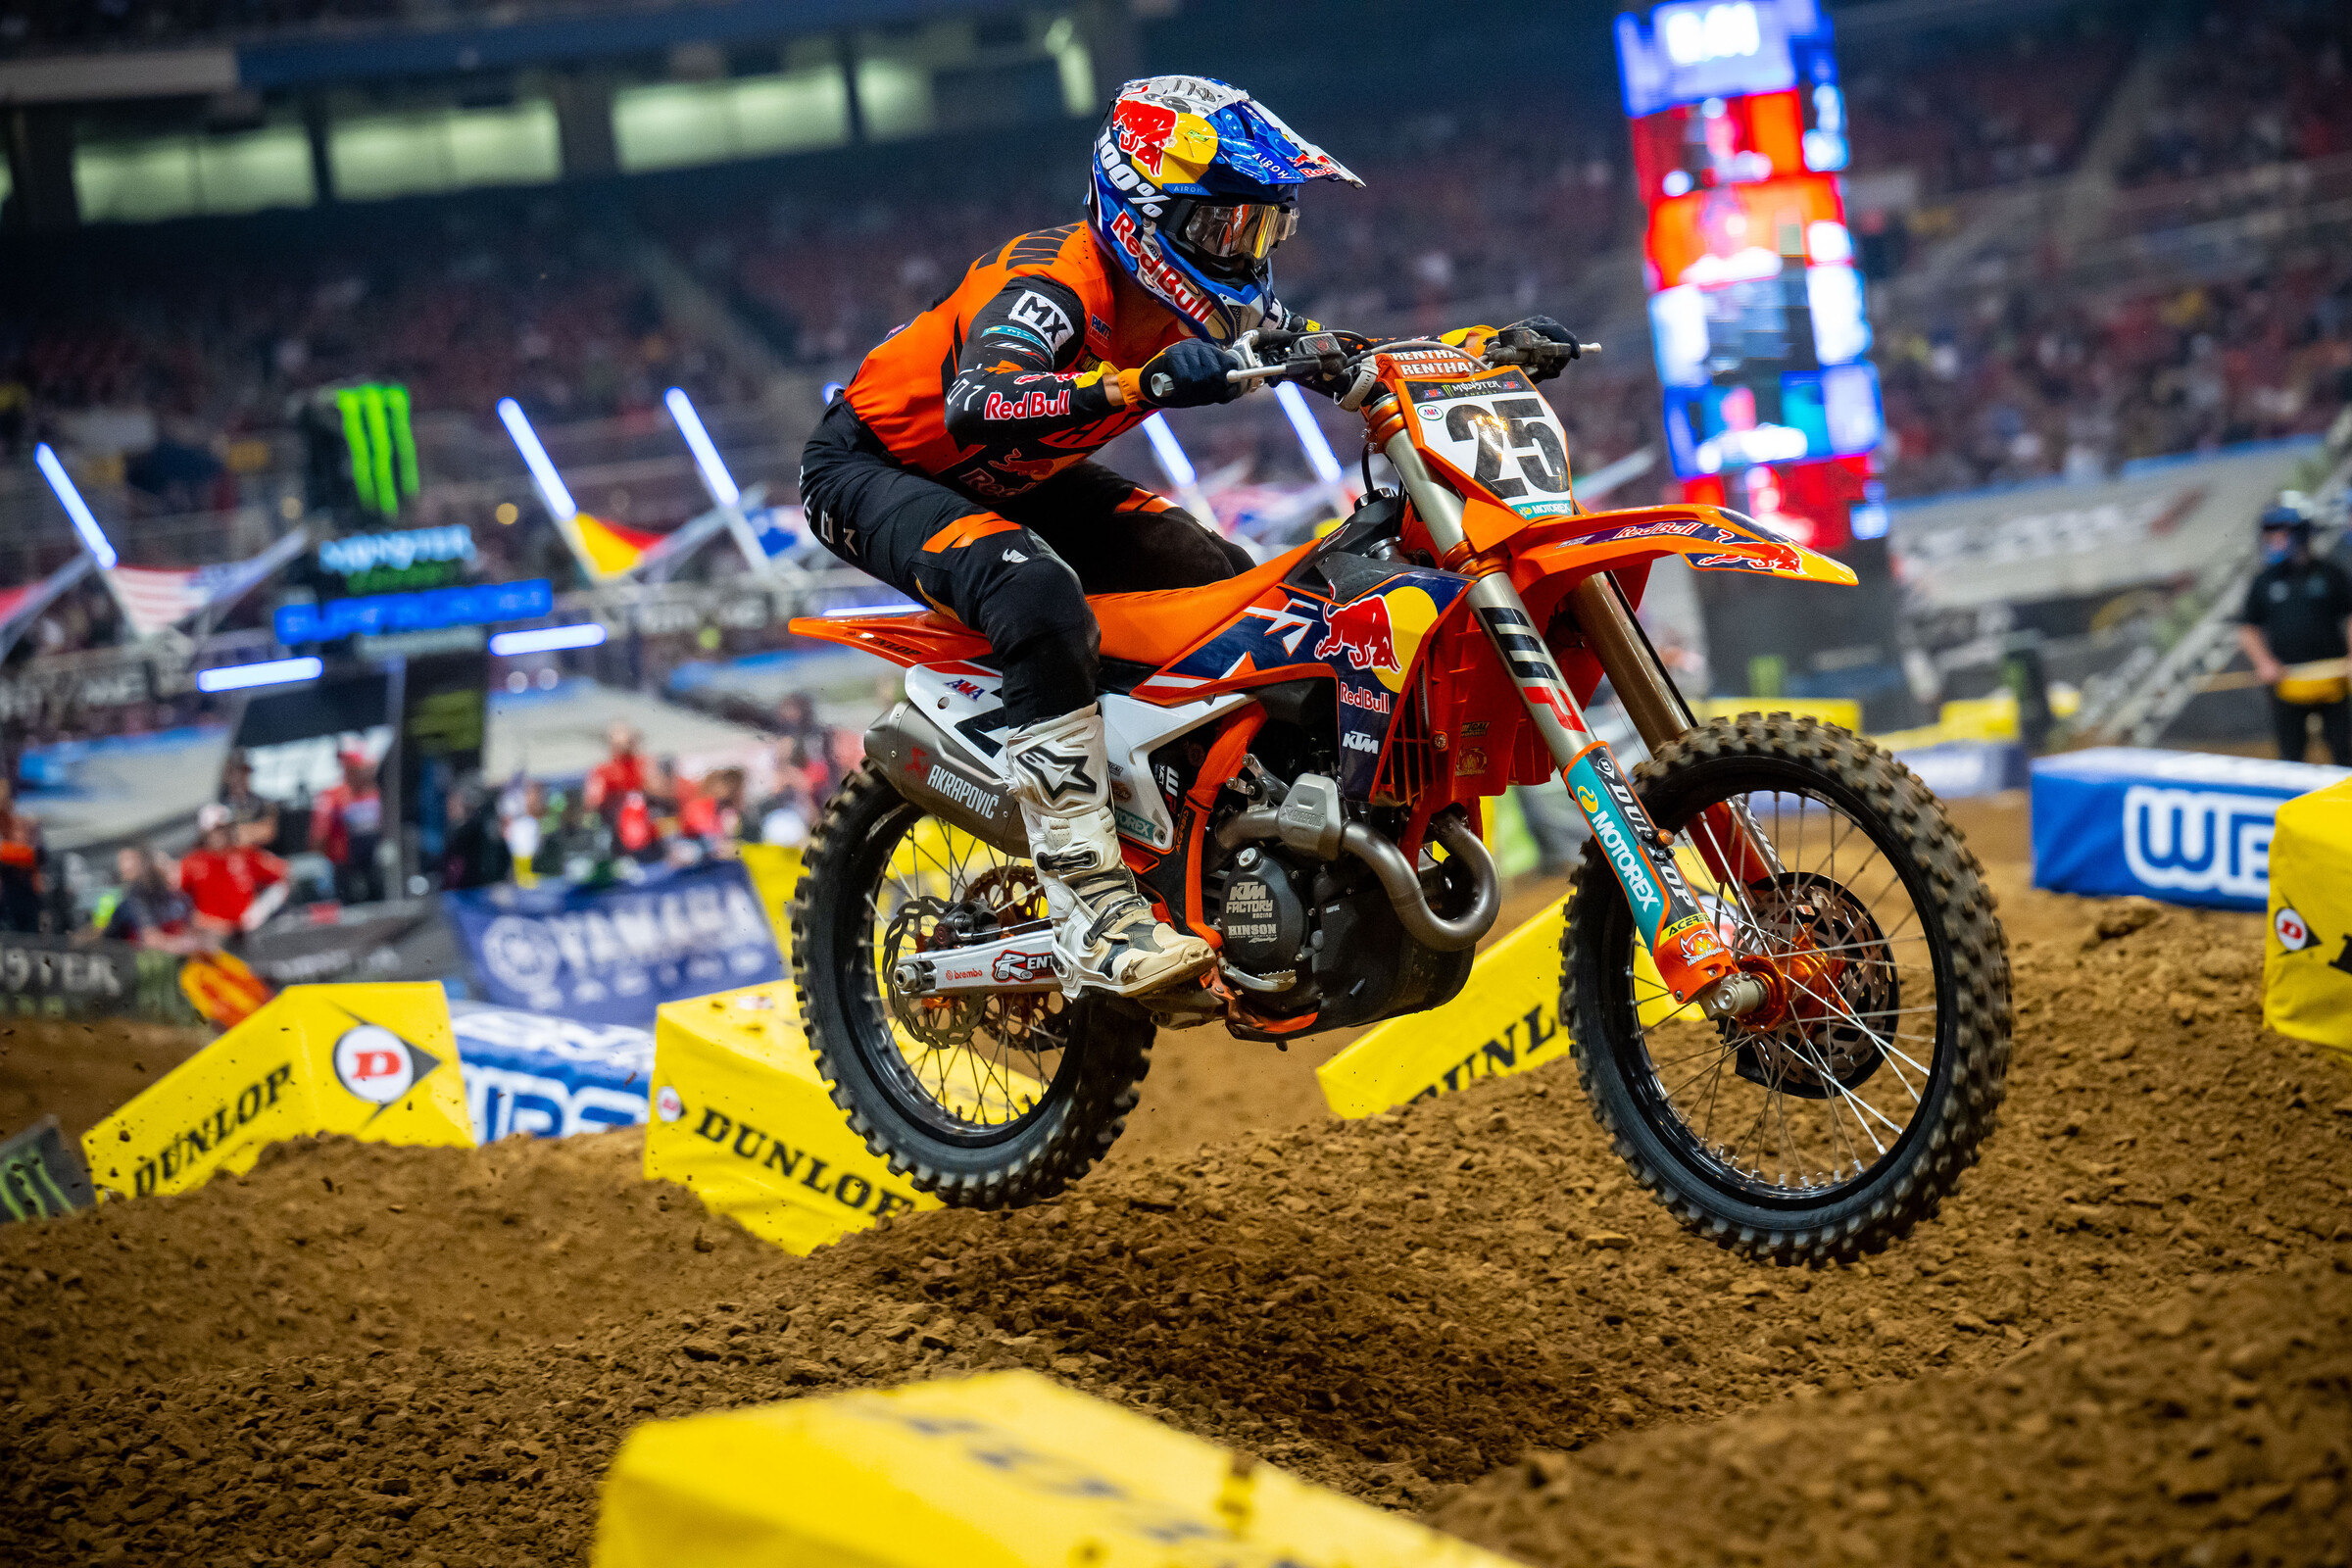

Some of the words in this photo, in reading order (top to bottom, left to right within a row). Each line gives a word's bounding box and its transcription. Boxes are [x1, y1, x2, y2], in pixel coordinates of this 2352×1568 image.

[1099, 125, 1171, 218] 100%
[1110, 209, 1163, 276] Red
[1156, 266, 1215, 323] Bull
[984, 391, 1030, 420] Red
[1030, 389, 1071, 417] Bull
[1446, 398, 1571, 500] 25
[1532, 503, 1570, 514] MOTOREX
[1612, 521, 1663, 539] Red
[1651, 521, 1703, 536] Bull
[1341, 681, 1363, 708] Red
[1363, 688, 1390, 714] Bull
[1342, 730, 1379, 755] KTM
[1592, 810, 1660, 912] MOTOREX
[1609, 783, 1695, 908] DUOP
[1226, 900, 1273, 913] FACTORY
[1229, 881, 1266, 901] KTM
[1228, 923, 1277, 936] HINSON
[954, 968, 983, 979] brembo
[134, 1062, 292, 1198] DUNLOP
[695, 1106, 914, 1217] DUNLOP
